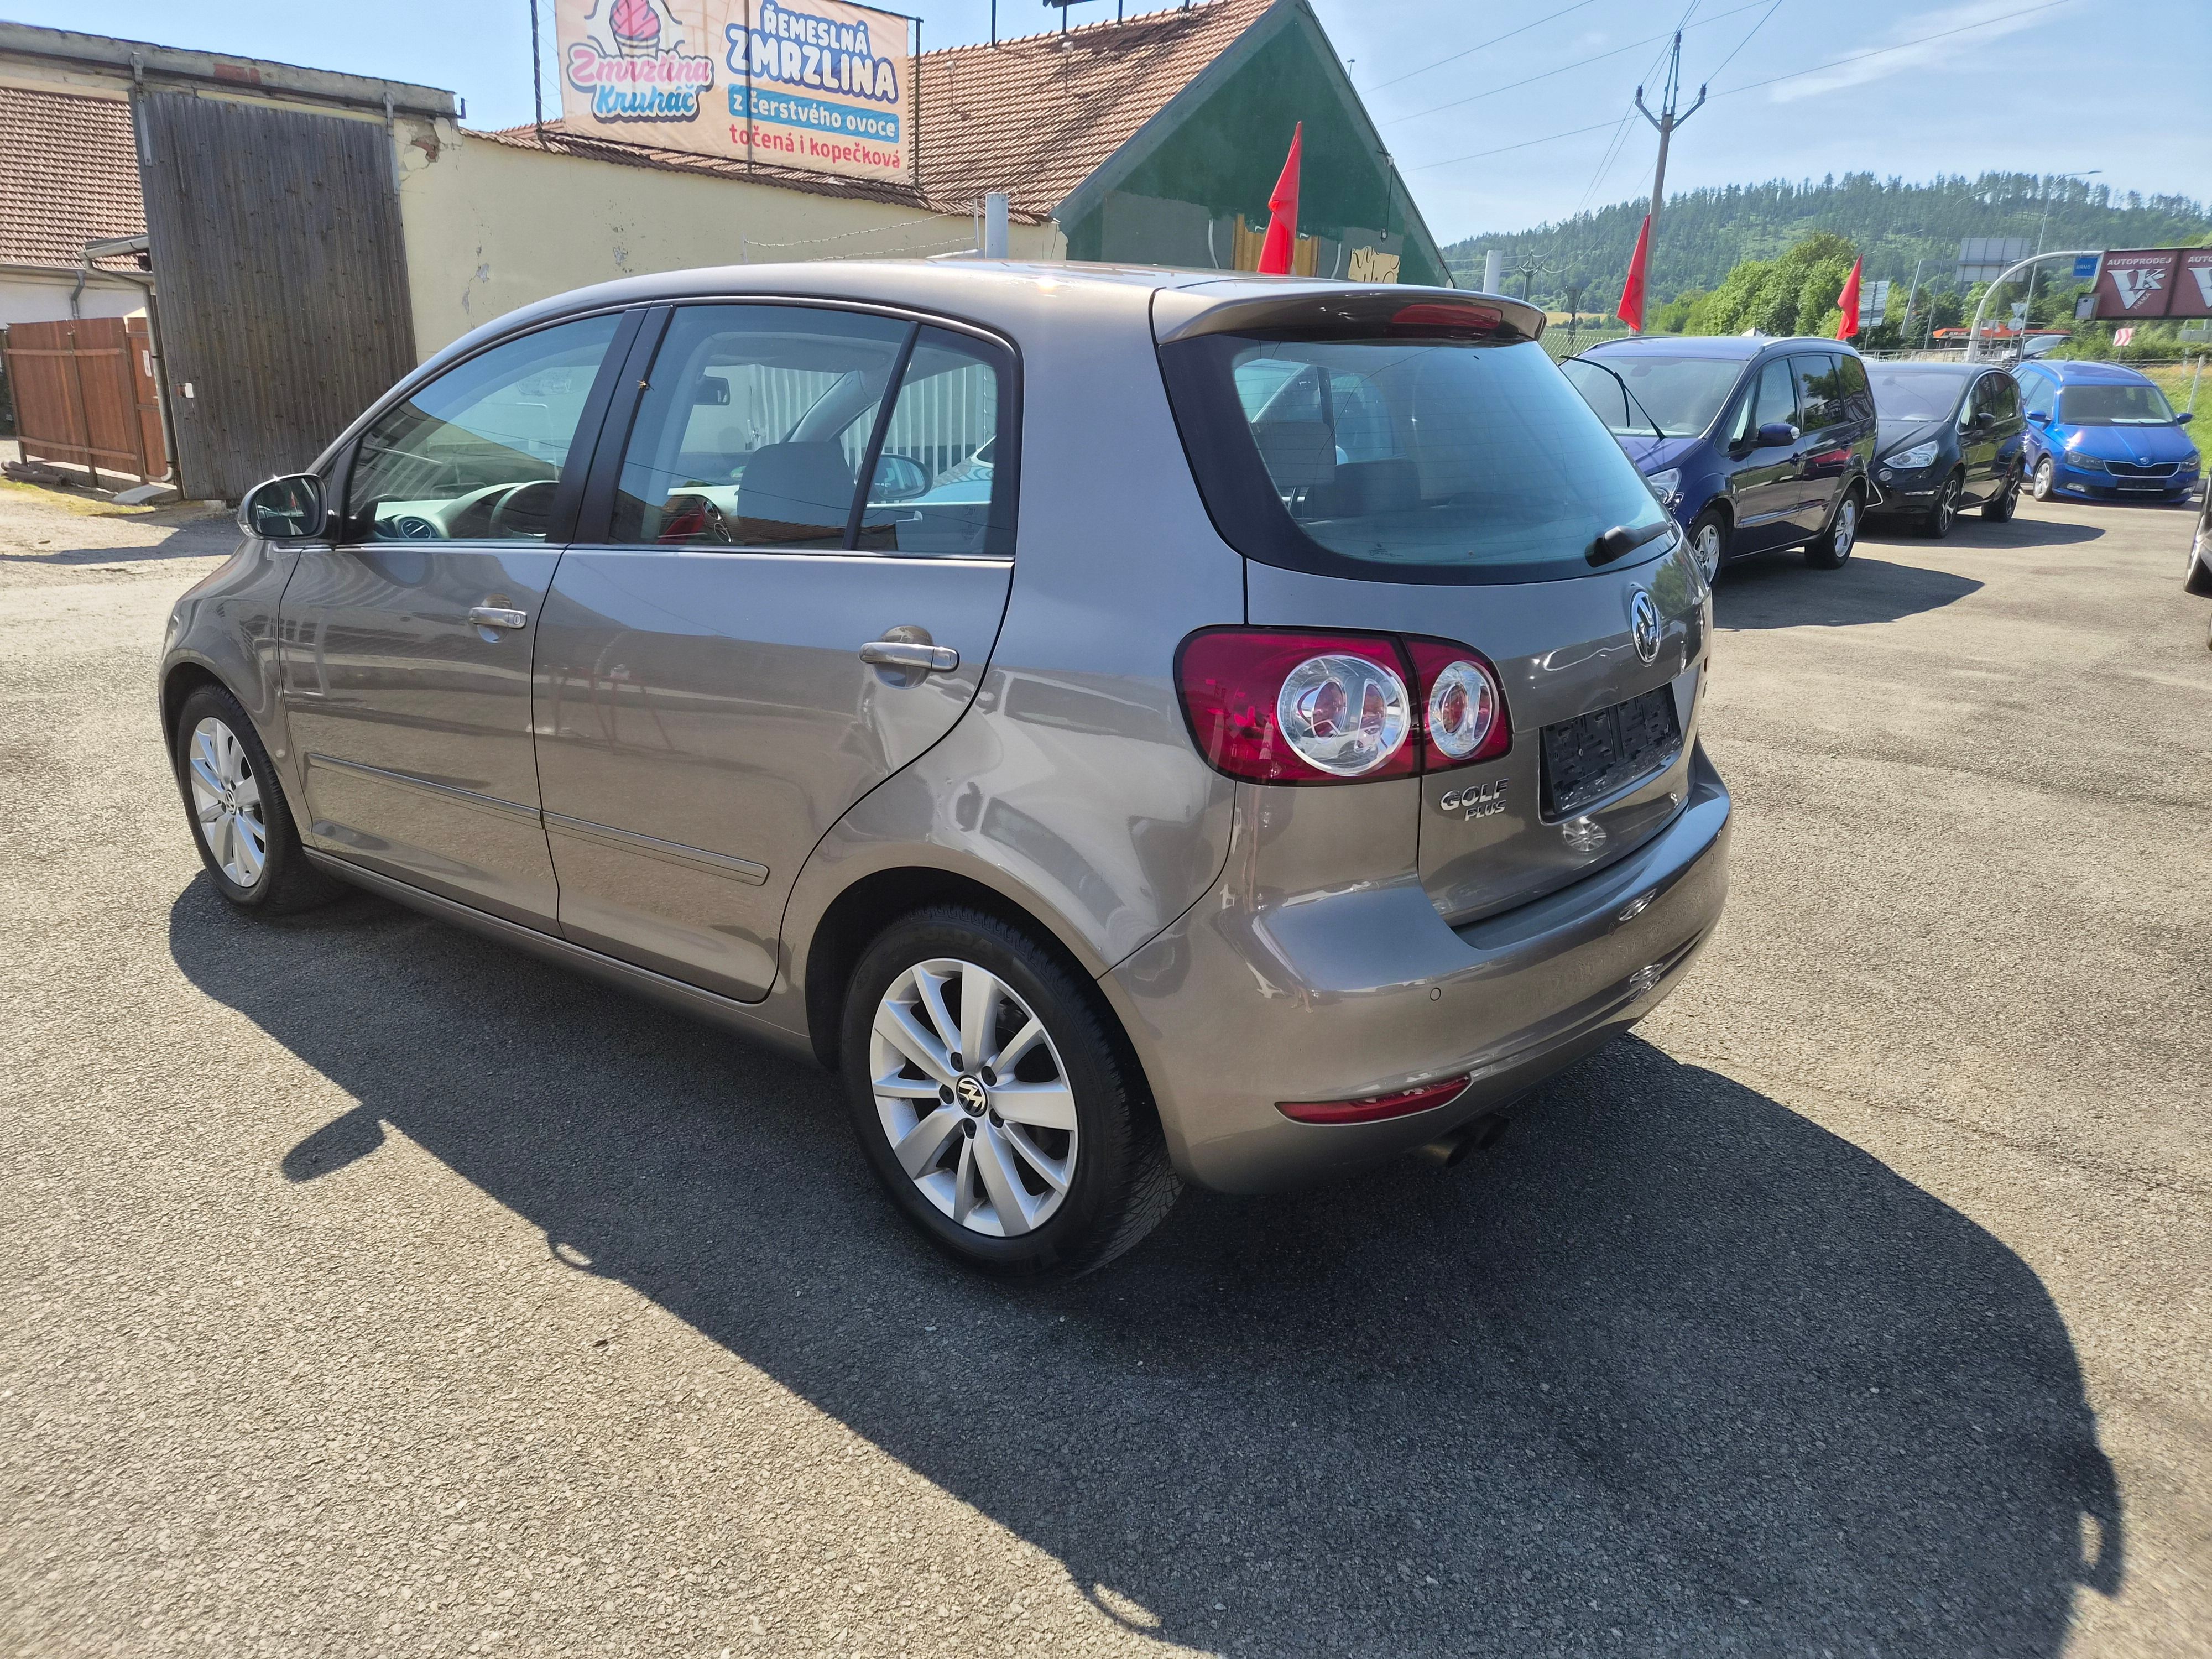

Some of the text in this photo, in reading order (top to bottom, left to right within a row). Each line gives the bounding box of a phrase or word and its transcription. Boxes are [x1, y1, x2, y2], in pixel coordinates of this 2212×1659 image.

[764, 4, 868, 55] ŘEMESLNÁ
[572, 49, 710, 82] Zmrzlina
[729, 28, 895, 100] ZMRZLINA
[596, 84, 695, 113] Kruháč
[733, 91, 895, 137] z čerstvého ovoce
[729, 124, 900, 169] točená i kopečková
[2107, 257, 2172, 265] AUTOPRODEJ
[2133, 292, 2152, 310] FIRMA
[1440, 778, 1509, 811] GOLF
[1464, 800, 1506, 821] PLUS
